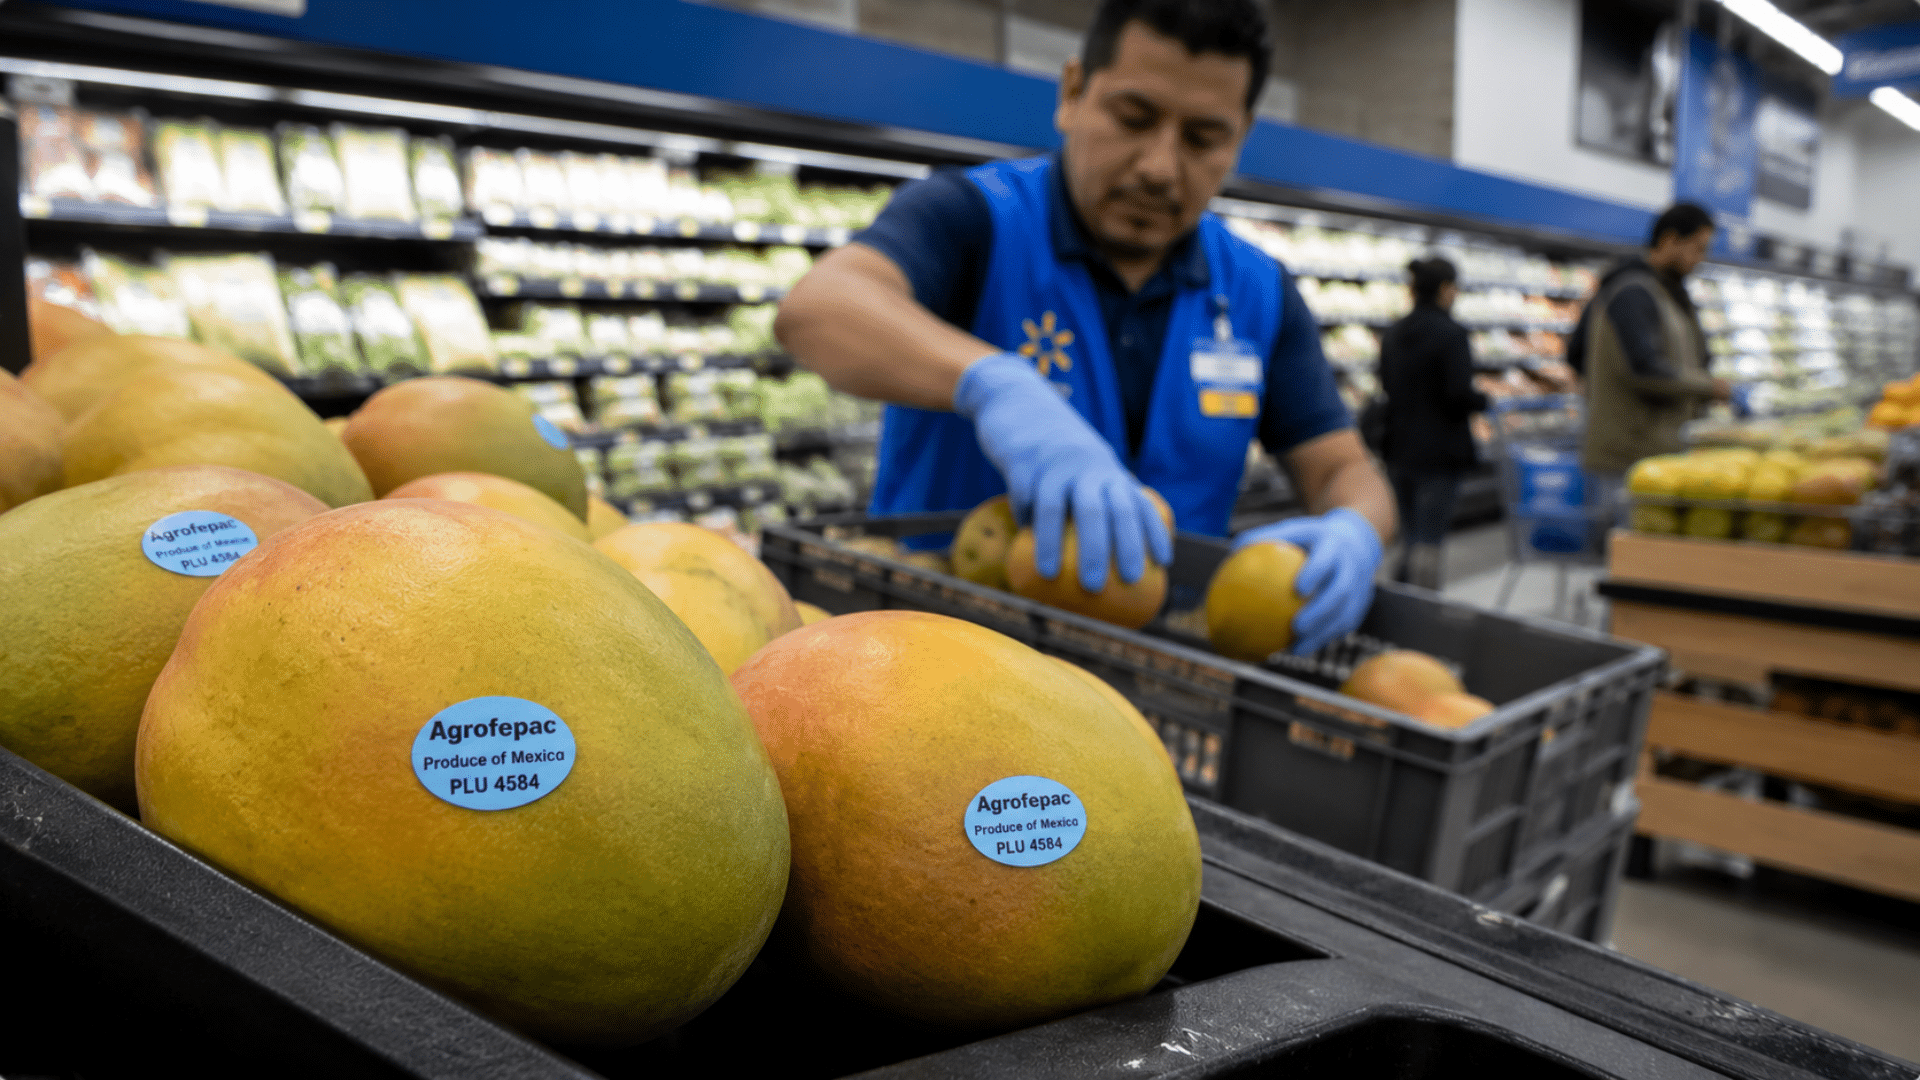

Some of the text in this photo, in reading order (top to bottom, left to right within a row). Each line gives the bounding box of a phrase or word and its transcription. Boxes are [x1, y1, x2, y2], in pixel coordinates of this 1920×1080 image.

[151, 520, 237, 543] Agrofepac
[181, 556, 208, 570] PLU
[429, 717, 557, 745] Agrofepac
[423, 754, 488, 771] Produce
[491, 751, 507, 766] of
[450, 773, 540, 795] PLU 4584
[977, 793, 1071, 815] Agrofepac
[974, 823, 1023, 836] Produce
[1026, 819, 1037, 831] of
[996, 837, 1062, 855] PLU 4584
